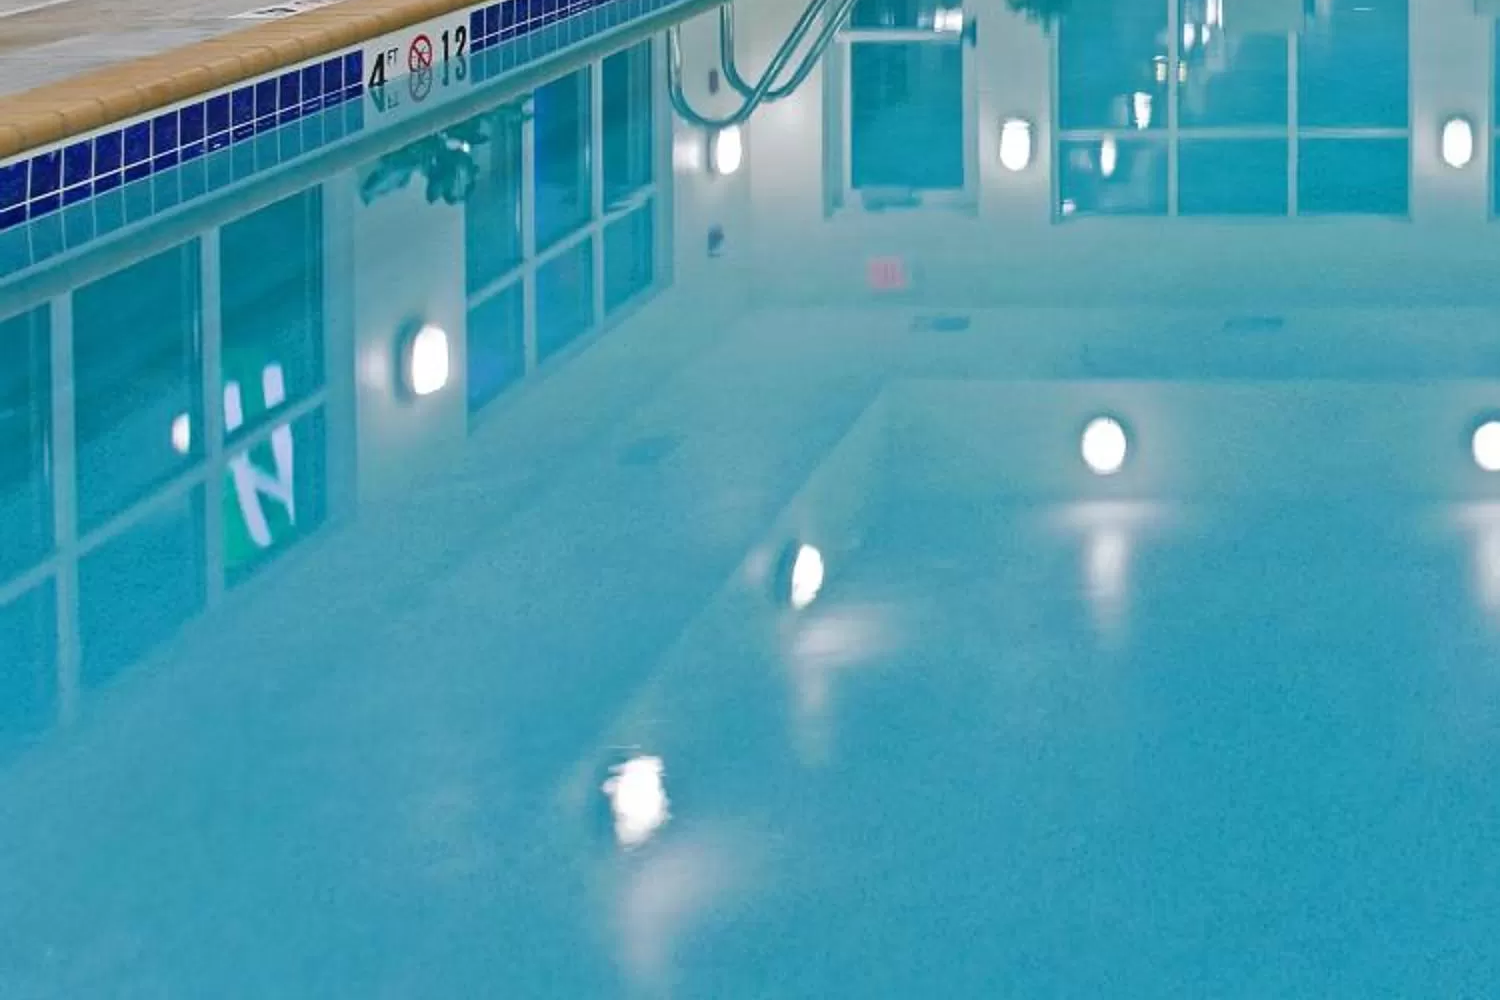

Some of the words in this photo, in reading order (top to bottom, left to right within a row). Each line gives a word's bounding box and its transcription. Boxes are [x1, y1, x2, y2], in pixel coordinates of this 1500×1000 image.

[441, 25, 467, 62] 12
[368, 52, 389, 88] 4
[387, 47, 399, 65] FT
